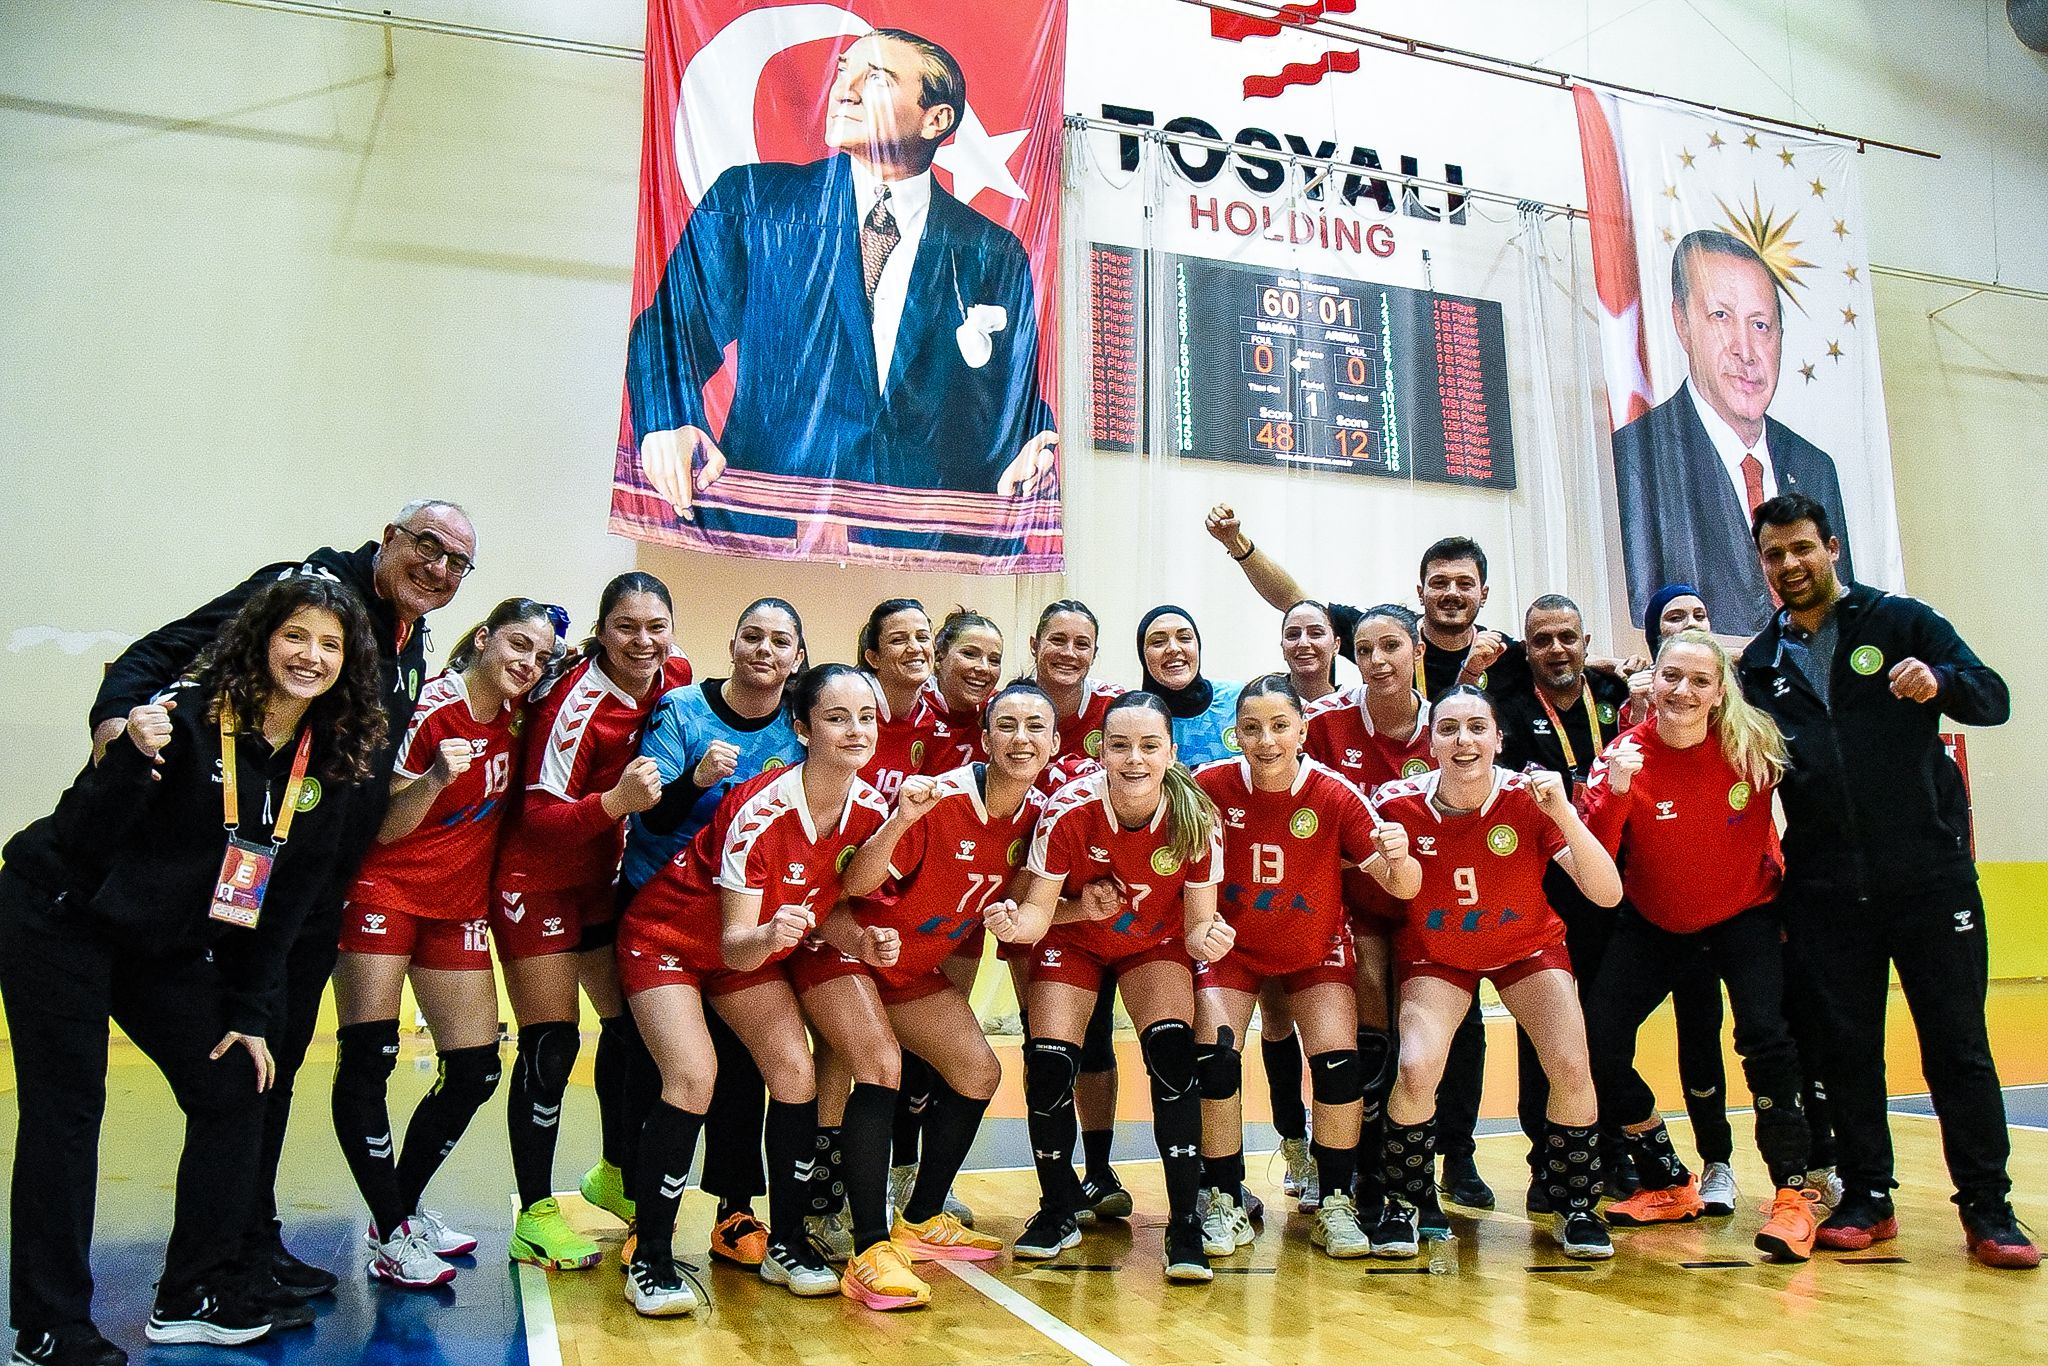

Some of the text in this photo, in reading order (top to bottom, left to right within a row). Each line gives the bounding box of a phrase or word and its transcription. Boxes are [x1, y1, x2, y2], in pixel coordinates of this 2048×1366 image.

[1101, 103, 1466, 226] TOSYALI
[1102, 251, 1132, 265] Player
[1102, 262, 1132, 276] Player
[1103, 274, 1132, 288] Player
[1103, 286, 1133, 298] Player
[1104, 298, 1134, 311] Player
[1451, 302, 1477, 315] Player
[1104, 310, 1134, 322] Player
[1452, 313, 1478, 325] Player
[1104, 321, 1134, 334] Player
[1453, 323, 1478, 336] Player
[1104, 333, 1135, 346] Player
[1453, 334, 1479, 347] Player
[1105, 346, 1135, 358] Player
[1454, 345, 1480, 357] Player
[1254, 345, 1274, 373] 0
[1455, 356, 1481, 369] Player
[1174, 366, 1189, 378] 10
[1348, 357, 1365, 385] 0
[1456, 367, 1481, 380] Player
[1457, 378, 1483, 390] Player
[1380, 391, 1395, 403] 10
[1458, 389, 1484, 401] Player
[1306, 392, 1318, 417] 1
[1256, 422, 1294, 450] 48
[1335, 429, 1369, 458] 12
[484, 752, 509, 798] 18
[875, 768, 904, 805] 19
[1249, 843, 1284, 884] 13
[1453, 867, 1479, 905] 9
[956, 873, 1003, 913] 77
